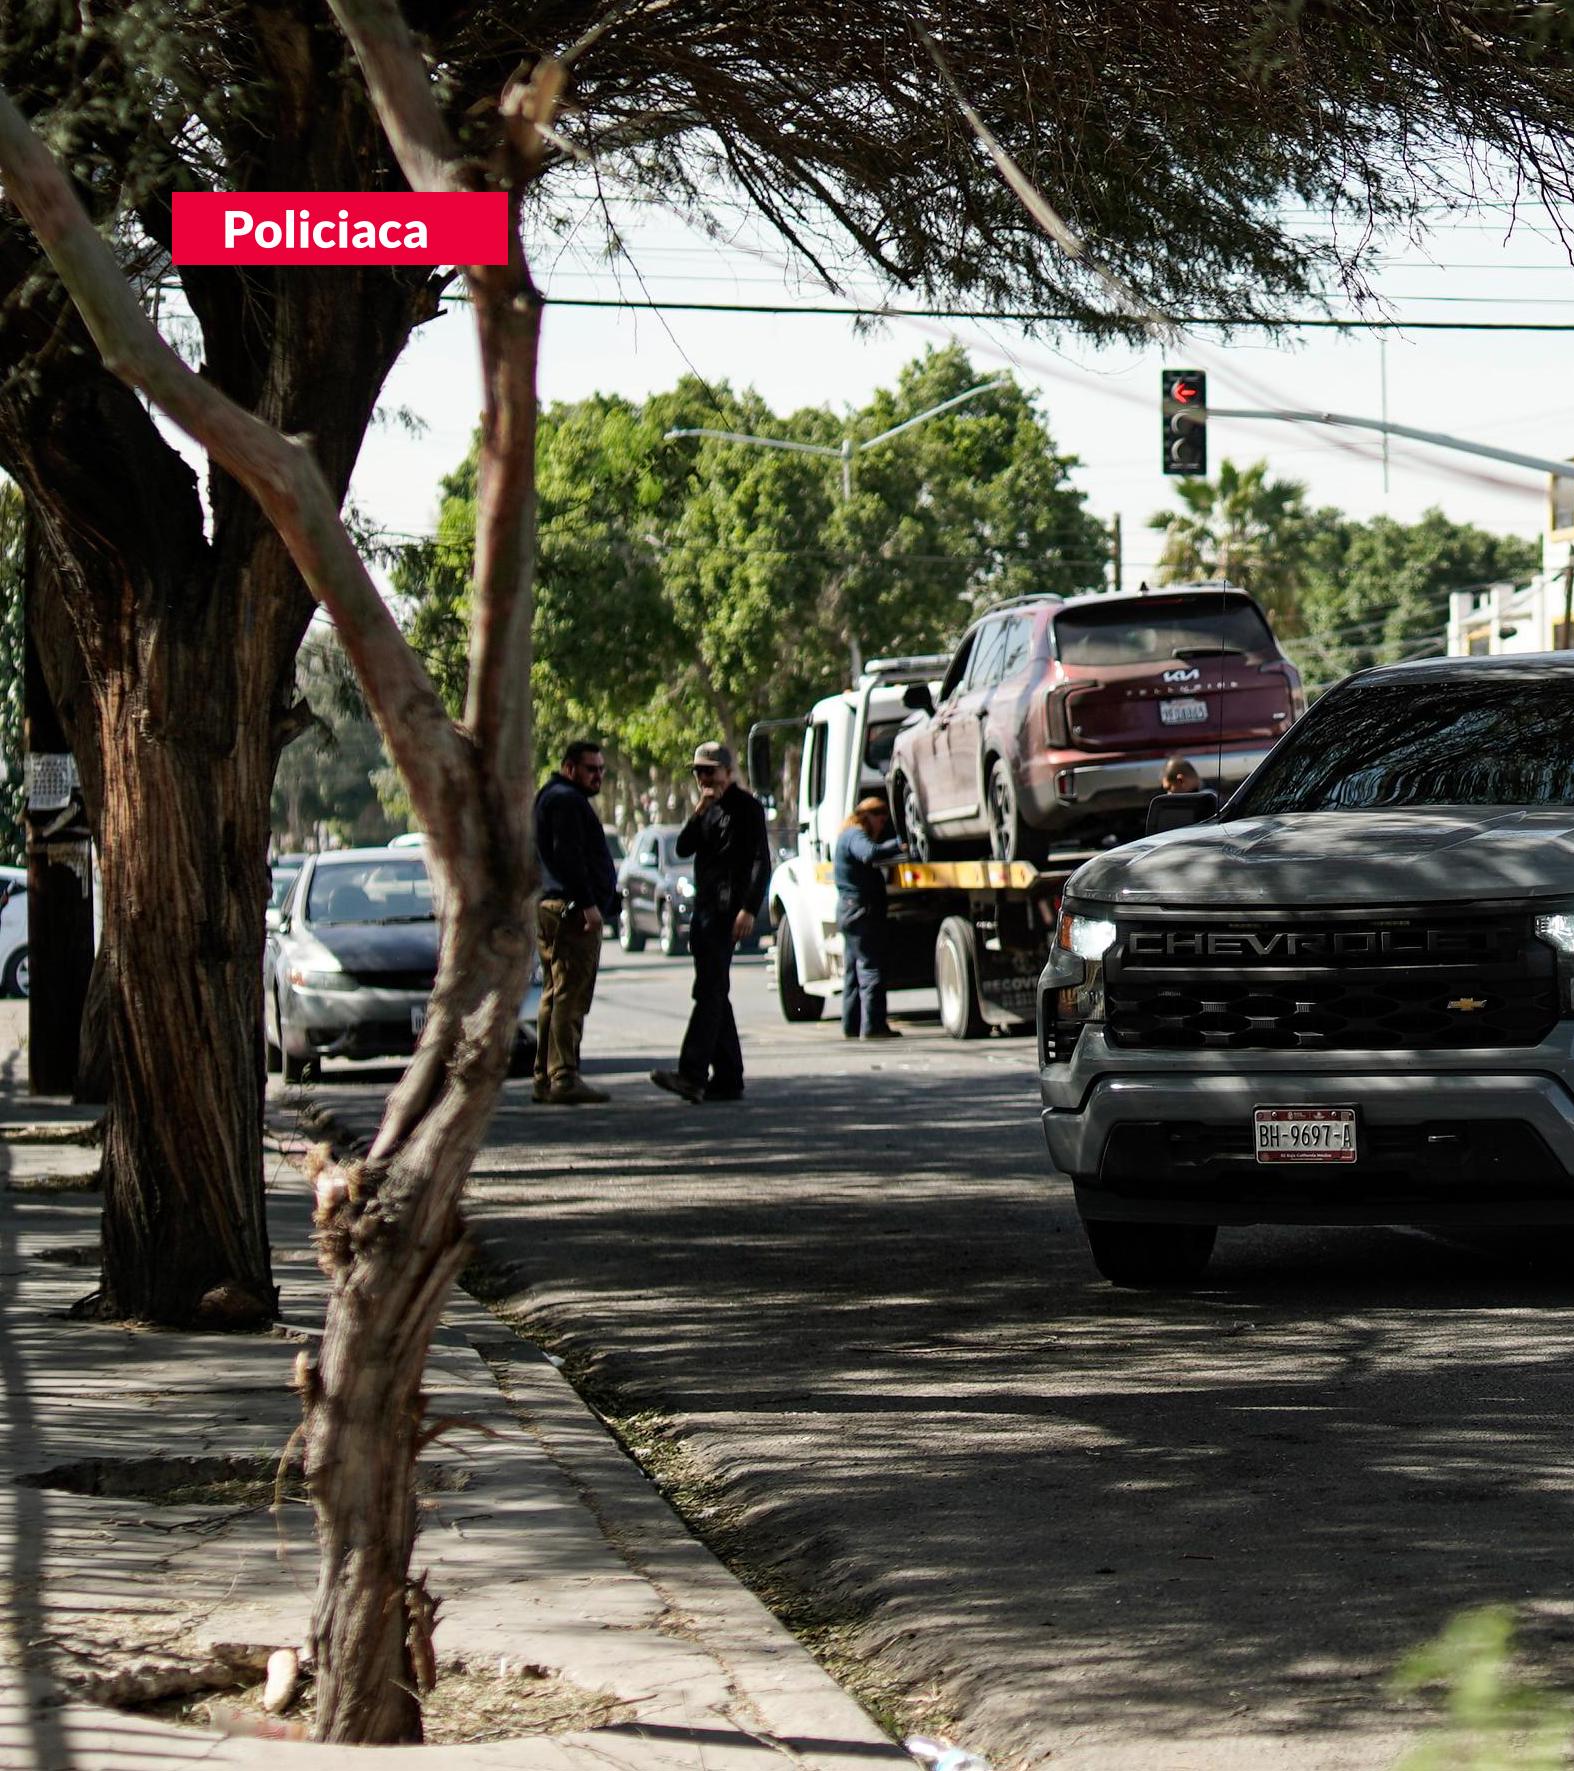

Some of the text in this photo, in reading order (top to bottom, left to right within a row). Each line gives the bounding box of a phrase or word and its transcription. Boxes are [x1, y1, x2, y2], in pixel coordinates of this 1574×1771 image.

[1163, 668, 1200, 683] KIA
[1129, 930, 1512, 956] CHEVROLET
[1259, 1123, 1353, 1148] BH-9697-A
